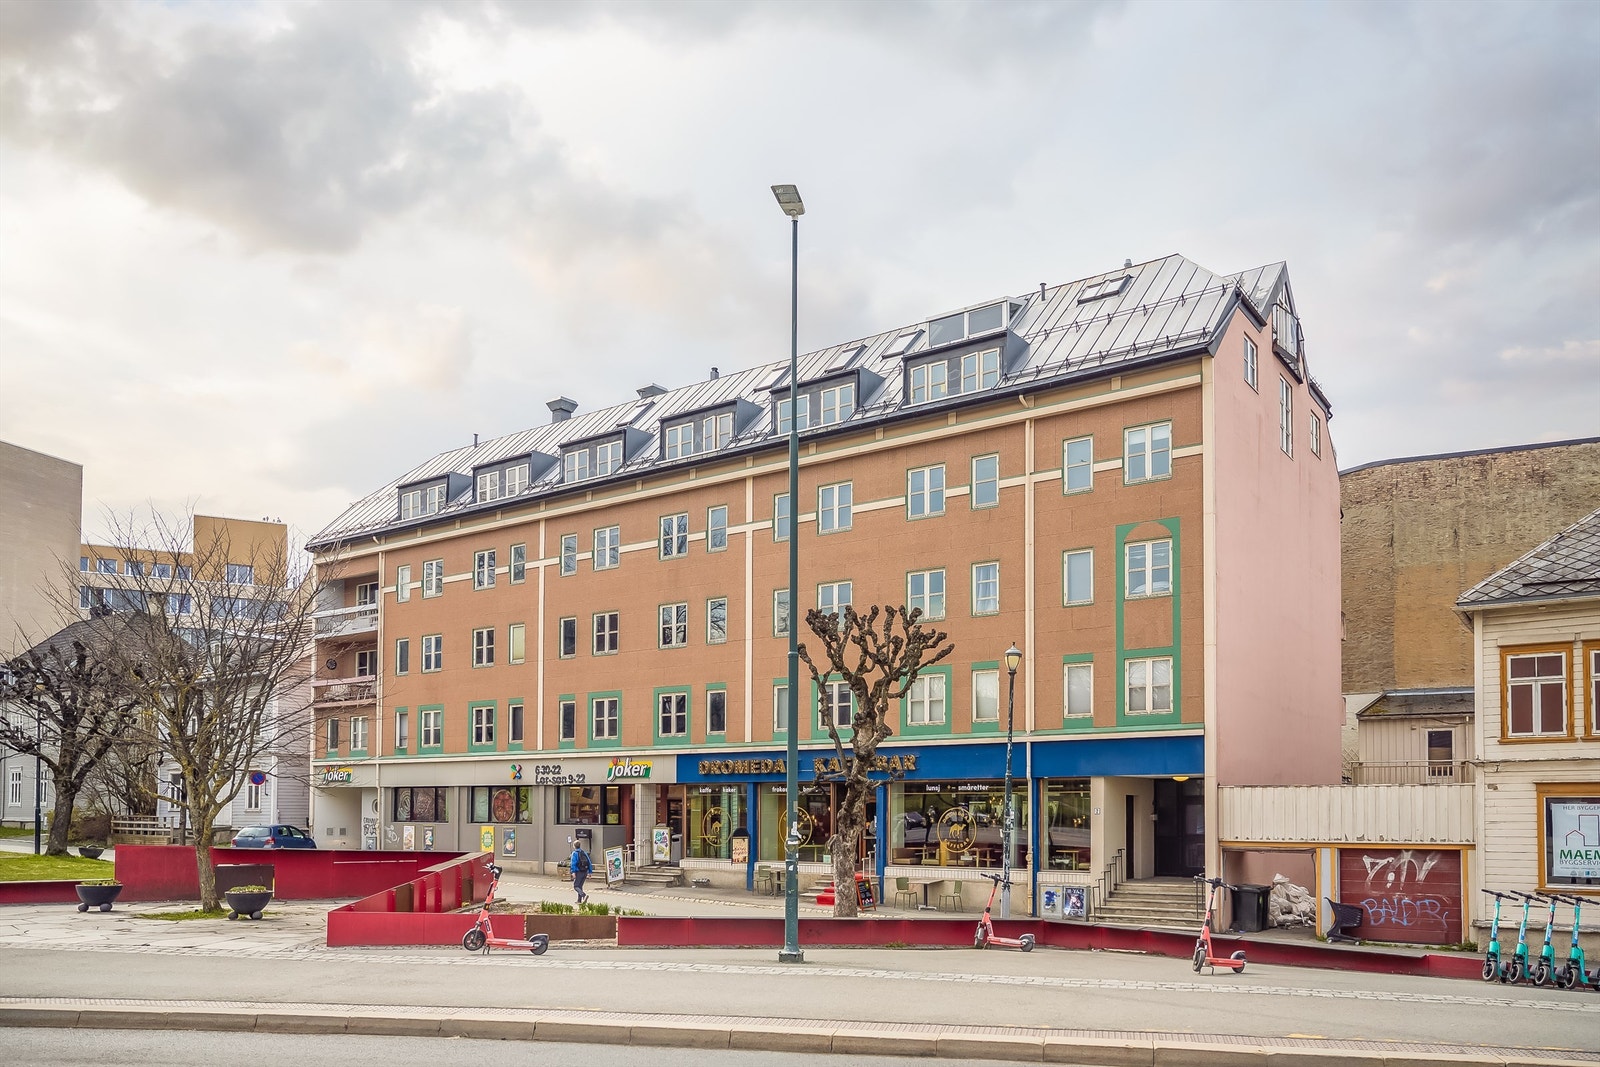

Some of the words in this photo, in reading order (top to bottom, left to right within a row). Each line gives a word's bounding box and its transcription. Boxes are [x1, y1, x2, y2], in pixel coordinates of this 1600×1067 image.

[607, 757, 647, 782] joker
[699, 759, 788, 775] DROMEDA
[814, 754, 916, 773] KABAR
[322, 765, 349, 785] joker
[925, 784, 941, 793] lunsj
